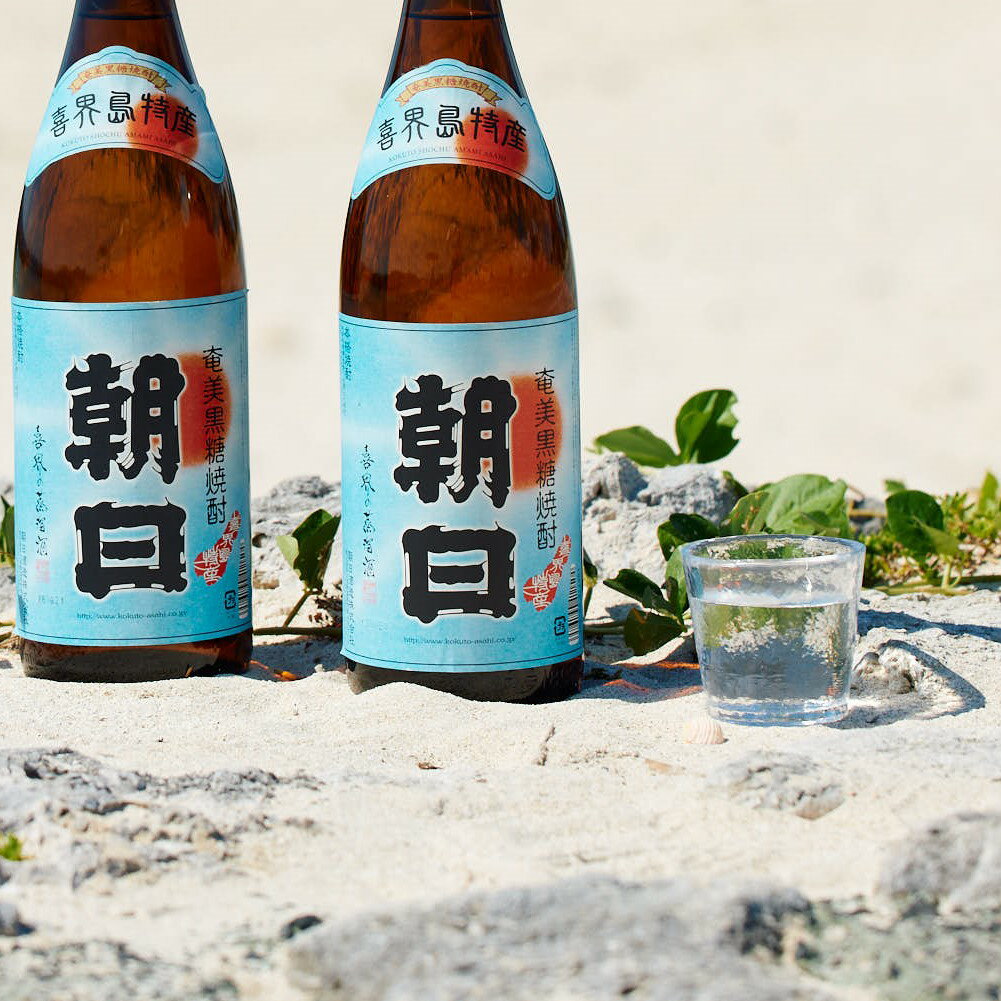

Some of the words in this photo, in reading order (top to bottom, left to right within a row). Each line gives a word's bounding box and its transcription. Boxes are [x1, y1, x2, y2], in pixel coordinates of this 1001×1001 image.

[50, 90, 198, 138] 喜界島特産
[376, 104, 528, 152] 喜界島特産
[65, 353, 187, 599] 朝日
[202, 345, 228, 525] 奄美黒糖焼酎
[393, 374, 517, 624] 朝日
[534, 367, 558, 551] 奄美黒糖焼酎
